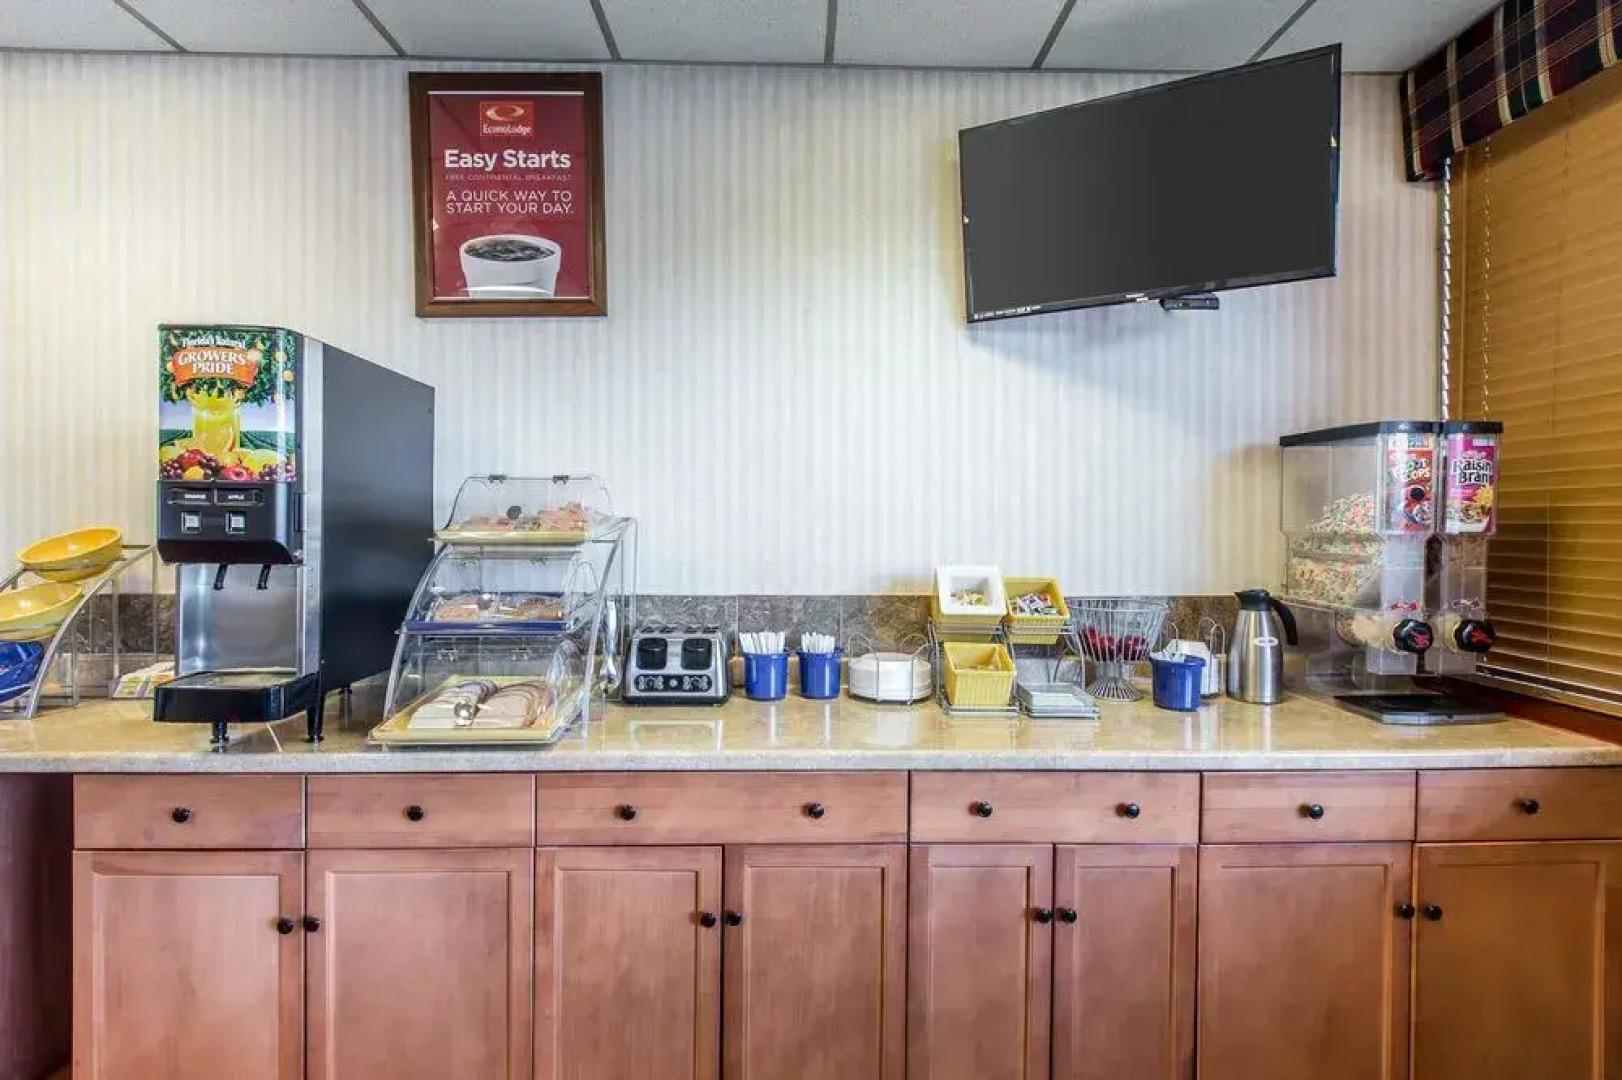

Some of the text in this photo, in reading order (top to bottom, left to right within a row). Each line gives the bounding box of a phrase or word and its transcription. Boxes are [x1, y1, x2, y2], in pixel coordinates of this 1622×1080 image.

[444, 149, 571, 172] Easy Starts
[445, 190, 572, 201] A QUICK WAY TO
[445, 202, 574, 214] START YOUR DAY.
[178, 350, 246, 366] GROWERS
[193, 362, 235, 374] PRIDE
[1453, 459, 1493, 476] Raisin
[1457, 471, 1490, 485] Bran
